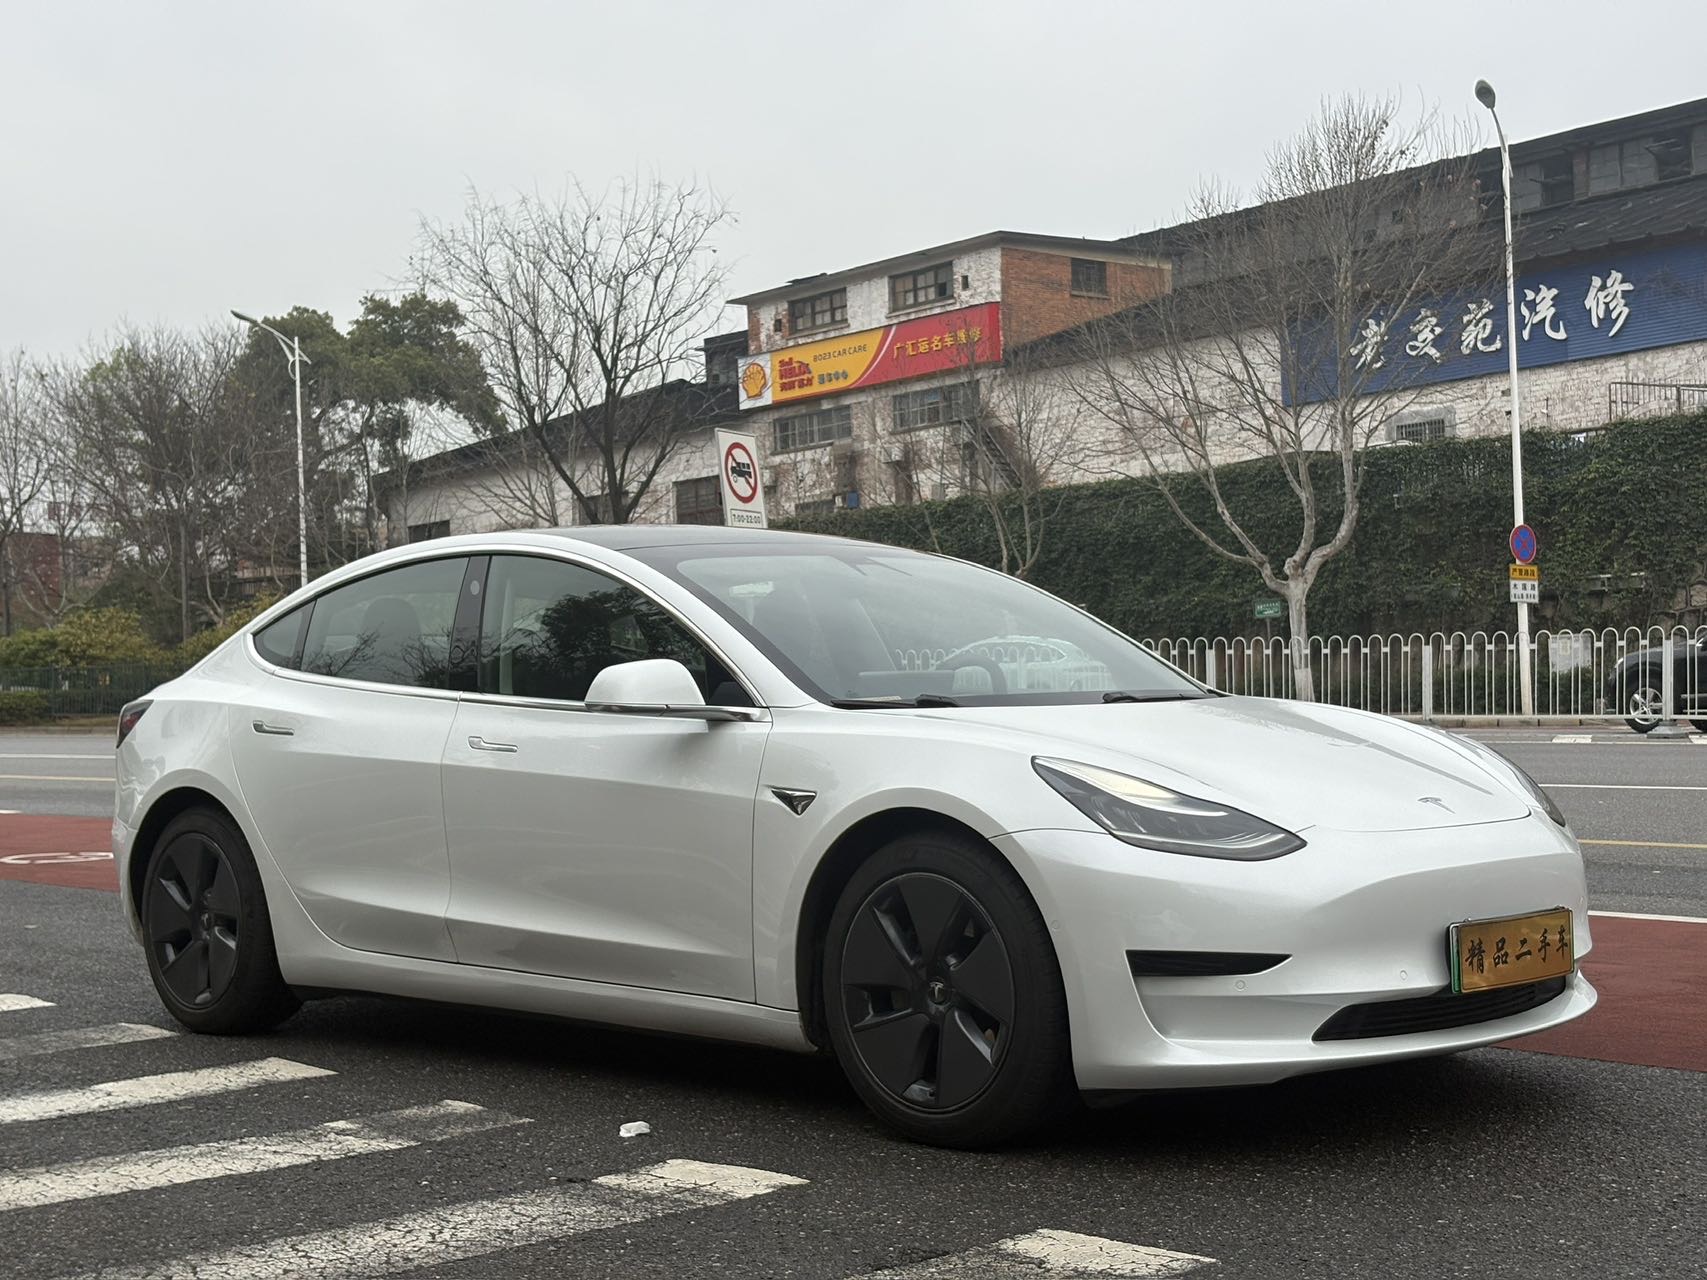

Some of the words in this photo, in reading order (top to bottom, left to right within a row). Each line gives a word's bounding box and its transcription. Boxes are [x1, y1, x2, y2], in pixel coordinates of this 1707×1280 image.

[832, 348, 847, 359] CAR
[848, 344, 868, 356] CARE
[1464, 925, 1568, 974] 精品二手车
